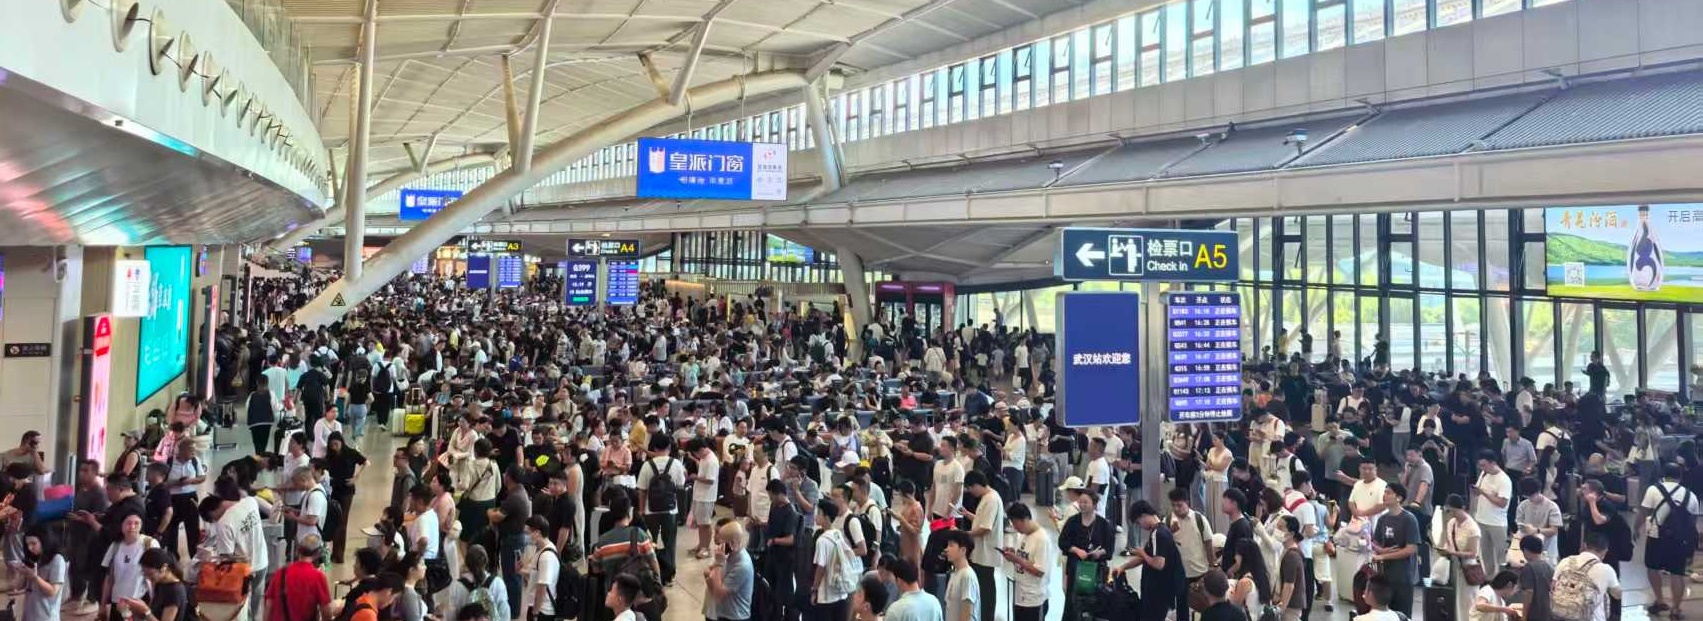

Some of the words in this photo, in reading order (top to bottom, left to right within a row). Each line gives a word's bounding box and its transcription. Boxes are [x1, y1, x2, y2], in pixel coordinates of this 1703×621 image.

[669, 152, 744, 172] 皇派门窗
[507, 242, 519, 251] A3
[620, 243, 635, 253] A4
[1147, 238, 1193, 257] 检票口
[1193, 243, 1228, 269] A5
[1147, 260, 1177, 271] Check
[1179, 260, 1188, 271] in
[1073, 352, 1131, 366] 武汉站欢迎您
